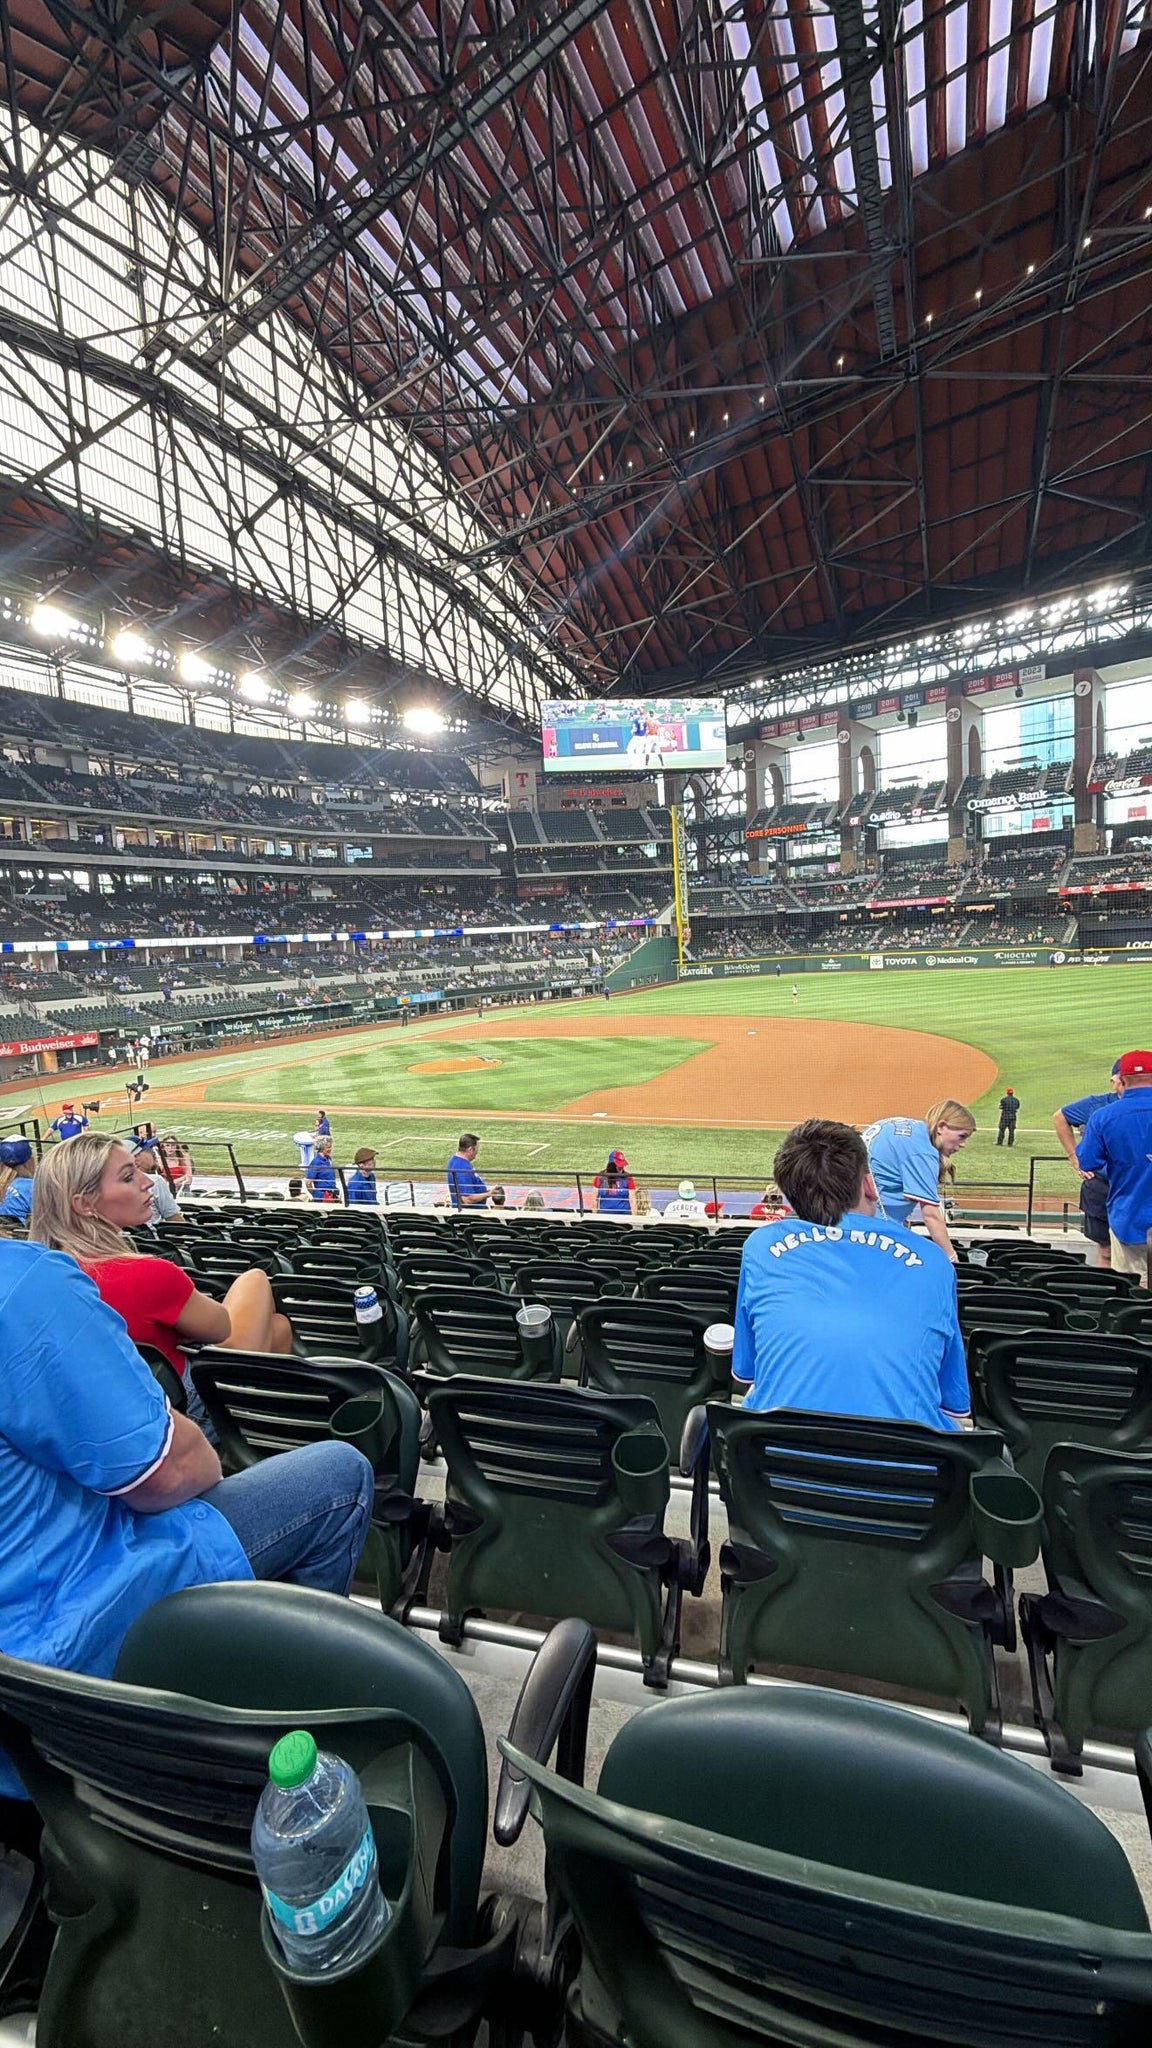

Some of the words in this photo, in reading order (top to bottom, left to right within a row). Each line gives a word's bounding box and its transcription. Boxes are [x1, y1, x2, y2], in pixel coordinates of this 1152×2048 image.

[1022, 666, 1042, 676] 2023
[967, 678, 985, 688] 2015
[929, 687, 946, 697] 2012
[1079, 684, 1088, 693] 7
[904, 693, 919, 702] 2011
[881, 699, 895, 707] 2011
[948, 710, 959, 719] 26
[745, 752, 754, 760] 42
[515, 772, 529, 787] T
[1018, 789, 1048, 803] Bank
[745, 829, 763, 839] CORE
[764, 823, 807, 837] PERSONNEL
[937, 955, 963, 965] Medical
[964, 955, 979, 965] City
[999, 951, 1038, 960] CHOCTAW
[884, 957, 918, 966] TOYOTA
[162, 1025, 184, 1033] TOYOTA
[20, 1039, 75, 1053] Budweiser
[672, 1203, 698, 1213] SEAGER
[769, 1226, 844, 1258] HELLO
[850, 1230, 924, 1267] KITTY
[319, 1842, 371, 1916] DASAN
